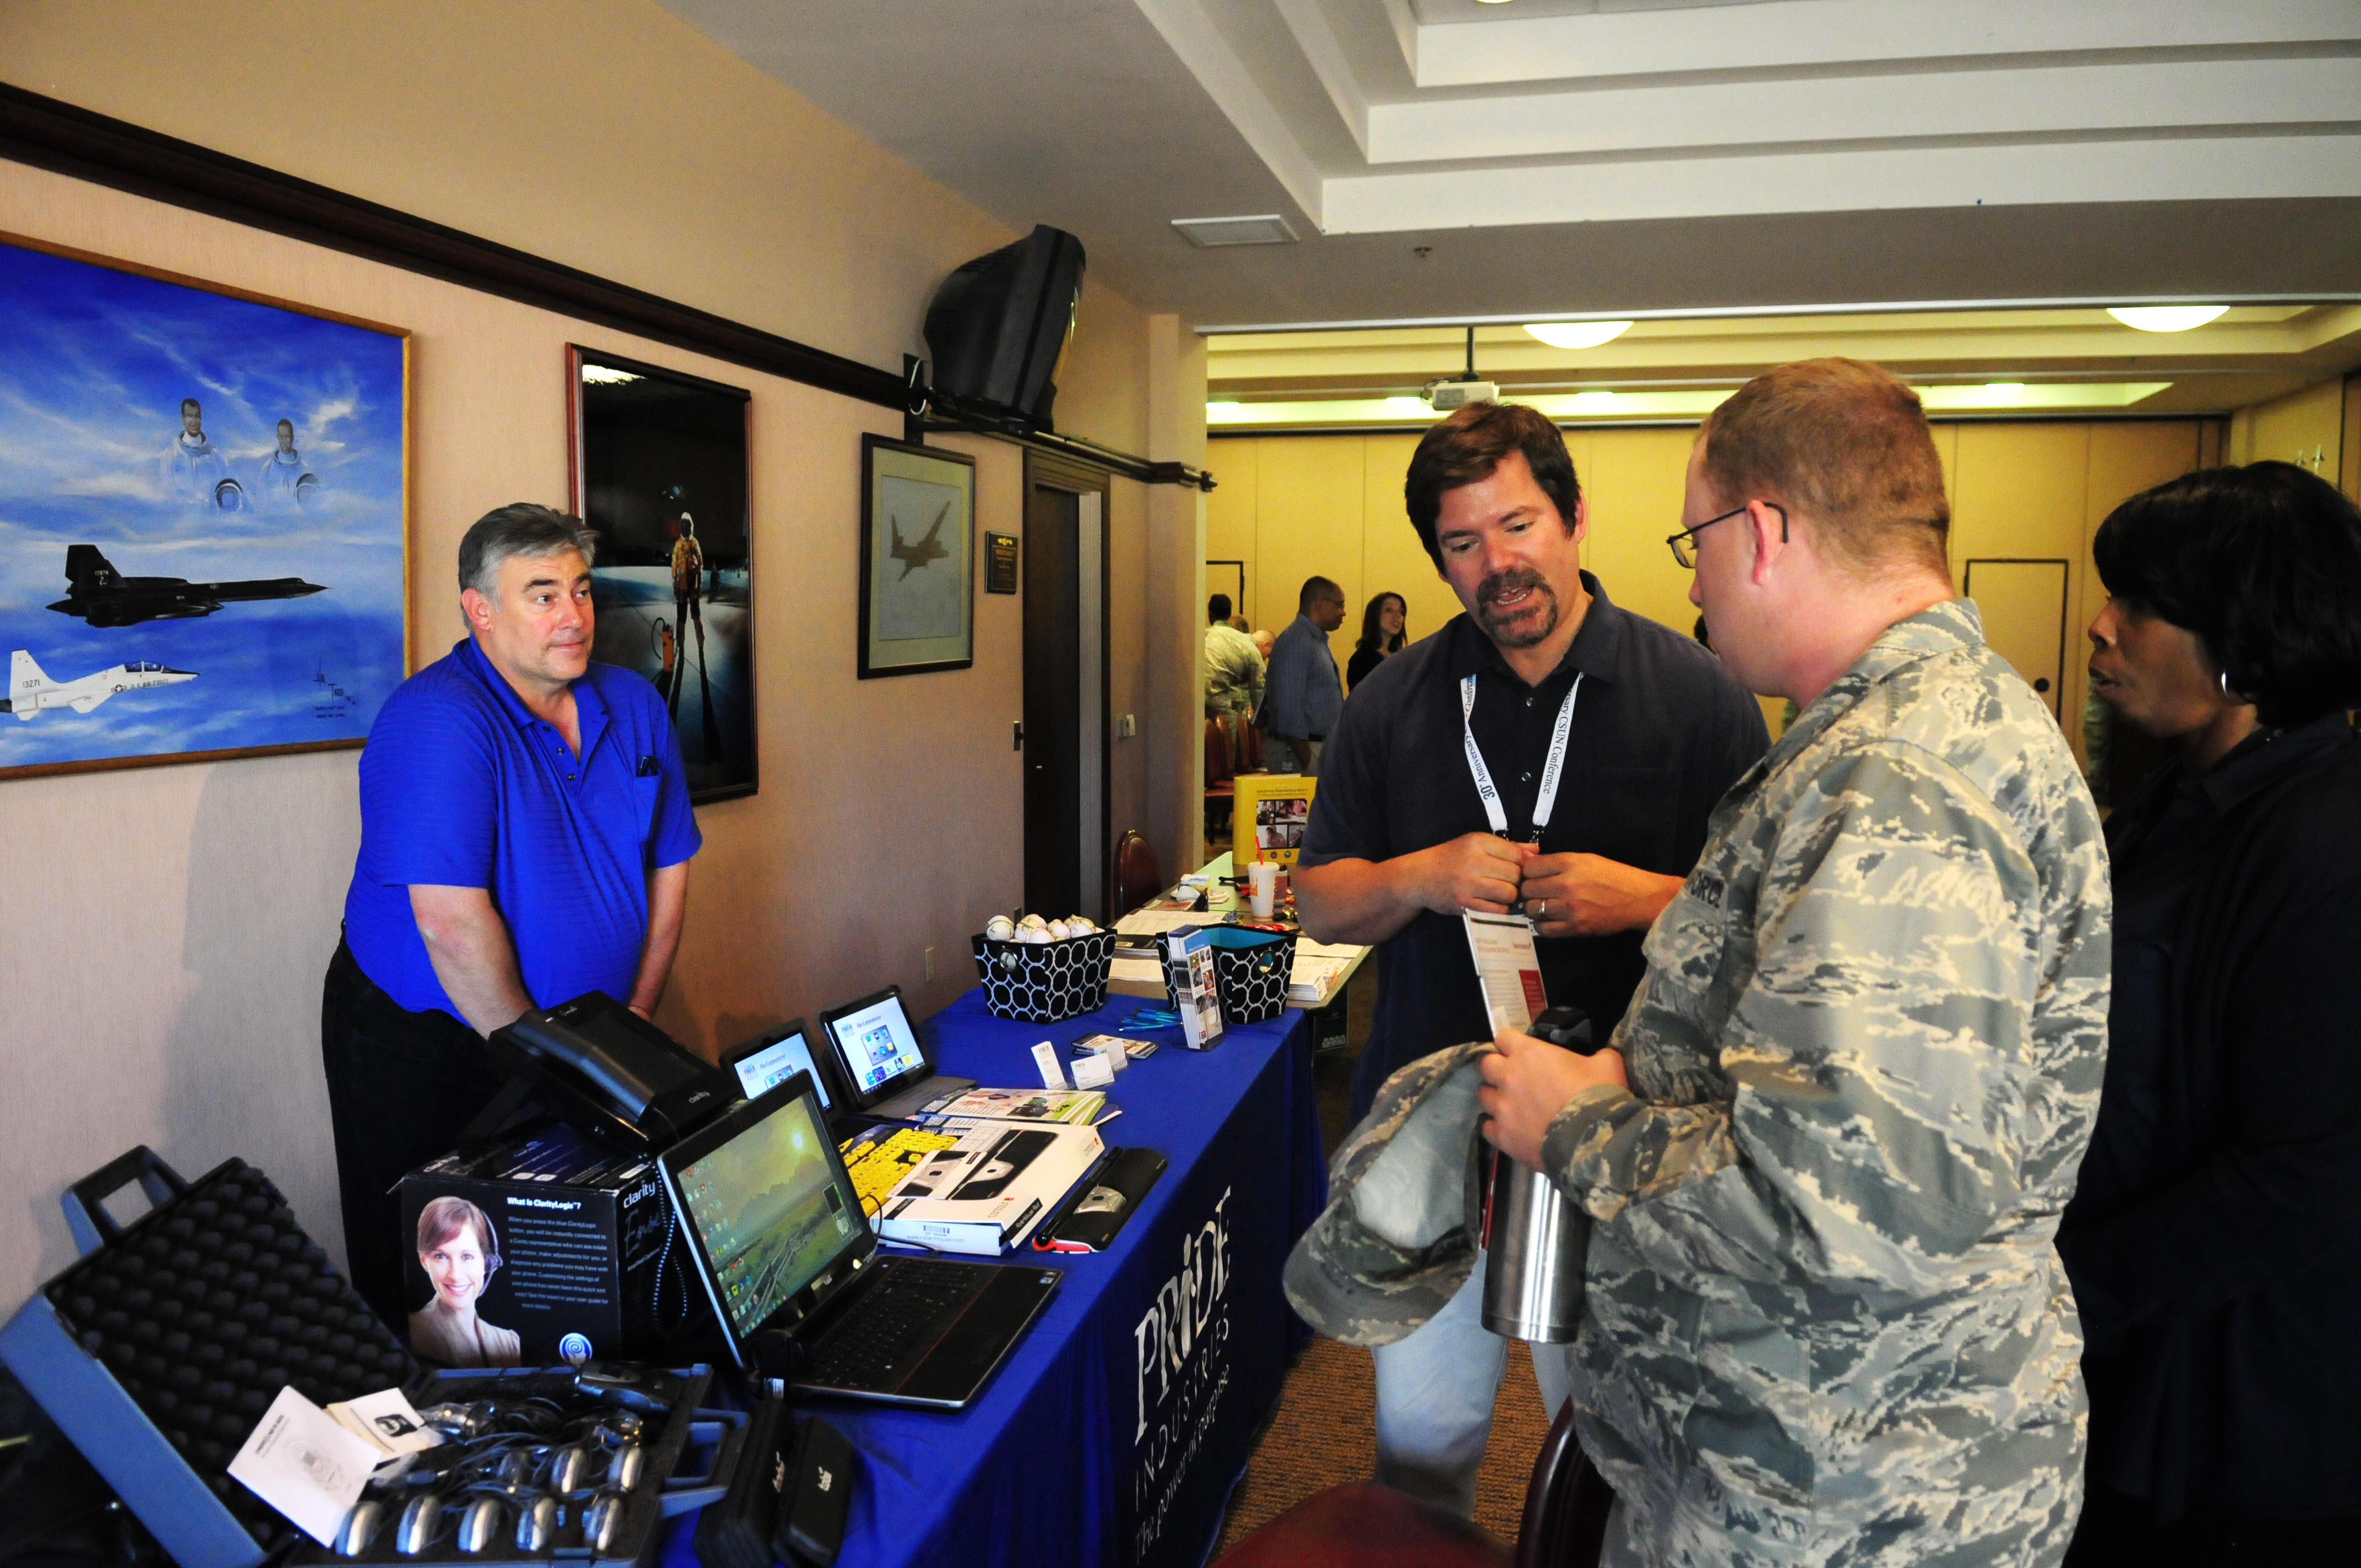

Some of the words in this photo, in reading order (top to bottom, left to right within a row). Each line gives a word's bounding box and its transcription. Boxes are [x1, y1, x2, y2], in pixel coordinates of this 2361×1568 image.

[23, 679, 40, 688] 13271
[1465, 676, 1473, 712] Conferen
[1555, 716, 1569, 744] CSUN
[1465, 736, 1487, 782] Anniversary
[1543, 746, 1563, 794] Conference
[507, 1196, 525, 1206] What
[623, 1180, 656, 1208] clarity
[906, 1234, 964, 1243] www.rollermouse.com
[1135, 1516, 1155, 1566] The
[1156, 1450, 1188, 1539] power
[1198, 1364, 1229, 1455] purpose
